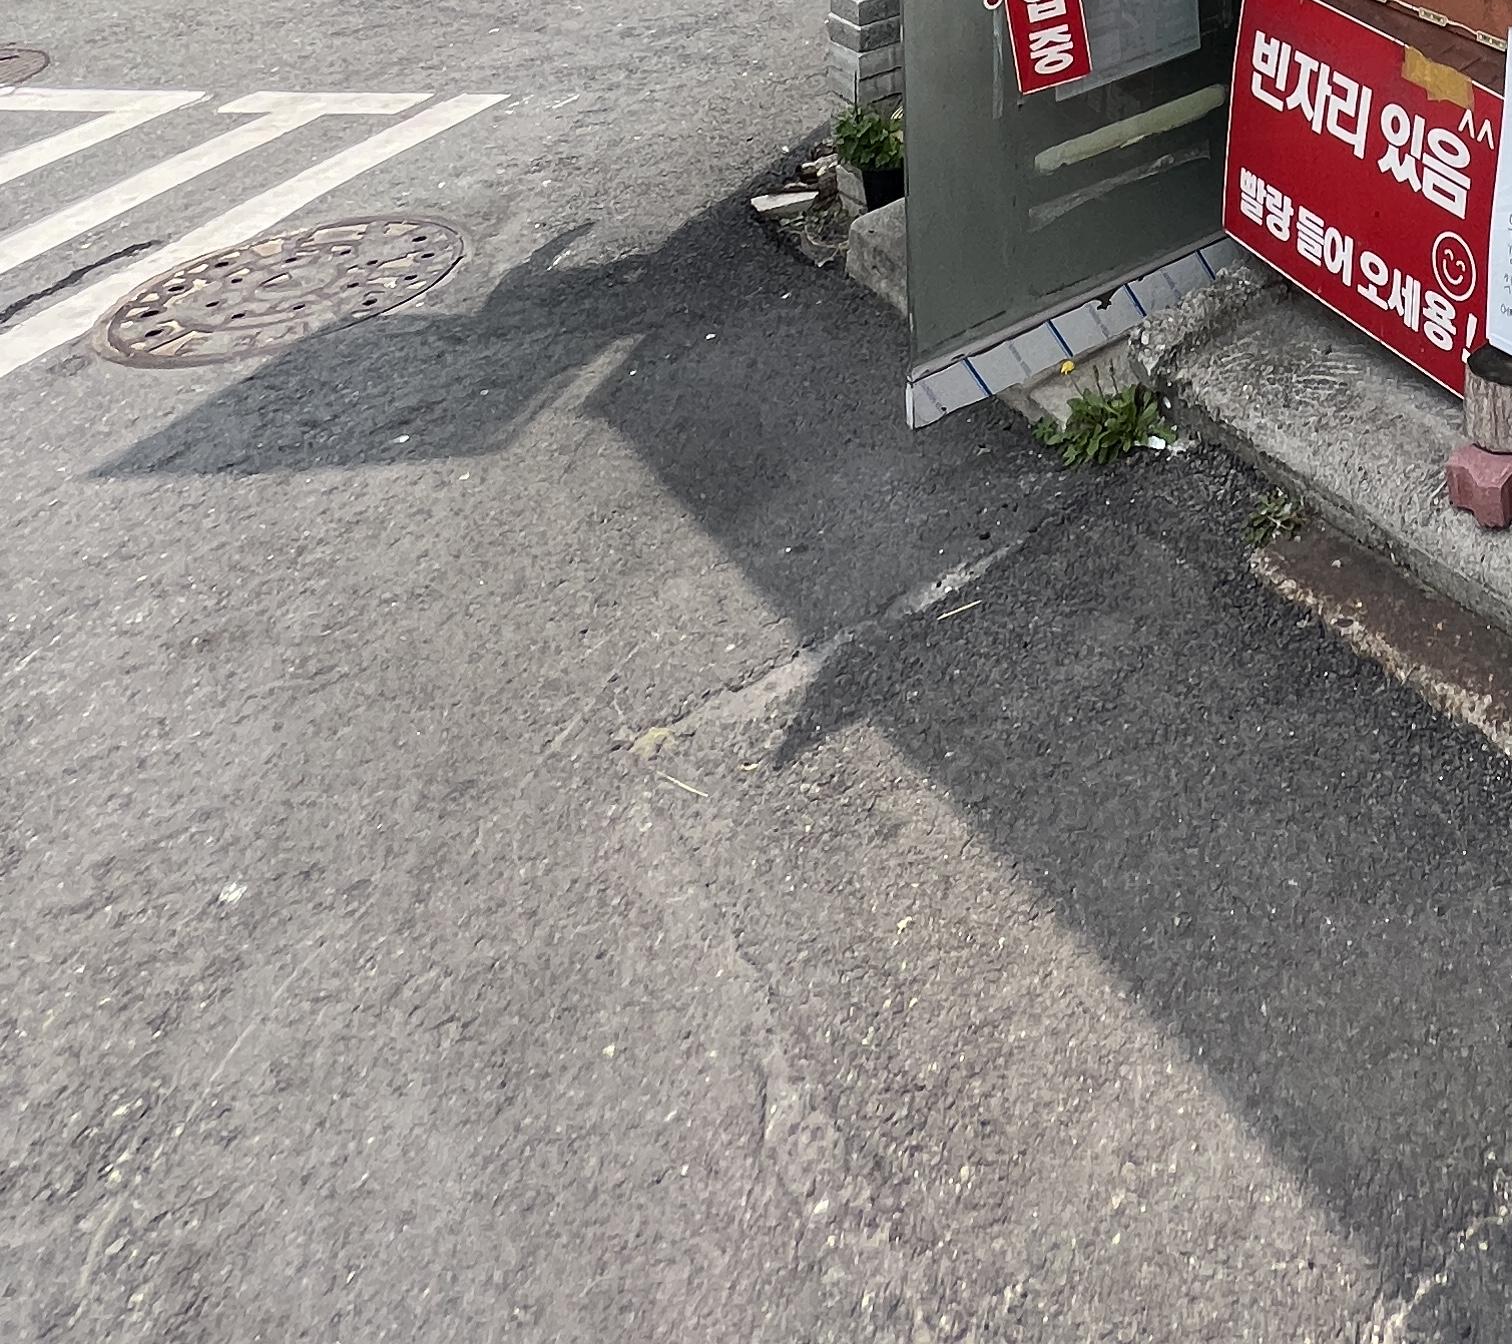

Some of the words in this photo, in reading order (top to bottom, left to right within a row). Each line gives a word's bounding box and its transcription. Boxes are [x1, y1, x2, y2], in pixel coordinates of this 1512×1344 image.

[1250, 30, 1373, 161] 빈자리
[1378, 102, 1472, 220] 있음
[1239, 166, 1294, 242] 빨랑
